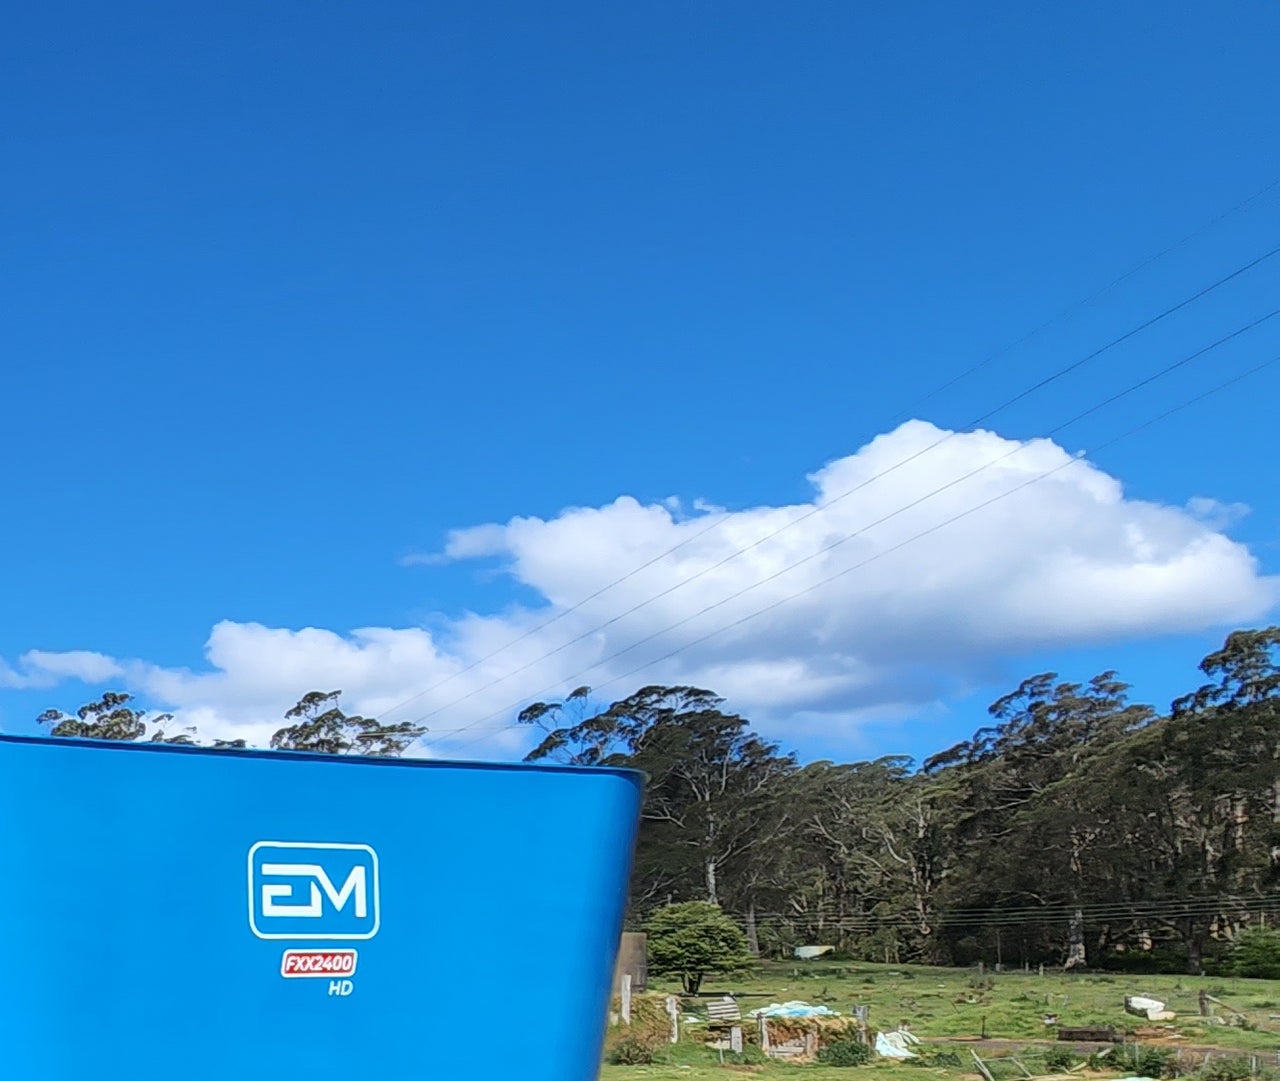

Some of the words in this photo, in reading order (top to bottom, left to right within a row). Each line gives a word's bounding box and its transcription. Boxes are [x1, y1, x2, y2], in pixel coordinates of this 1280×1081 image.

[261, 863, 367, 918] EM
[285, 955, 353, 972] FXX2400
[328, 980, 354, 996] HD
